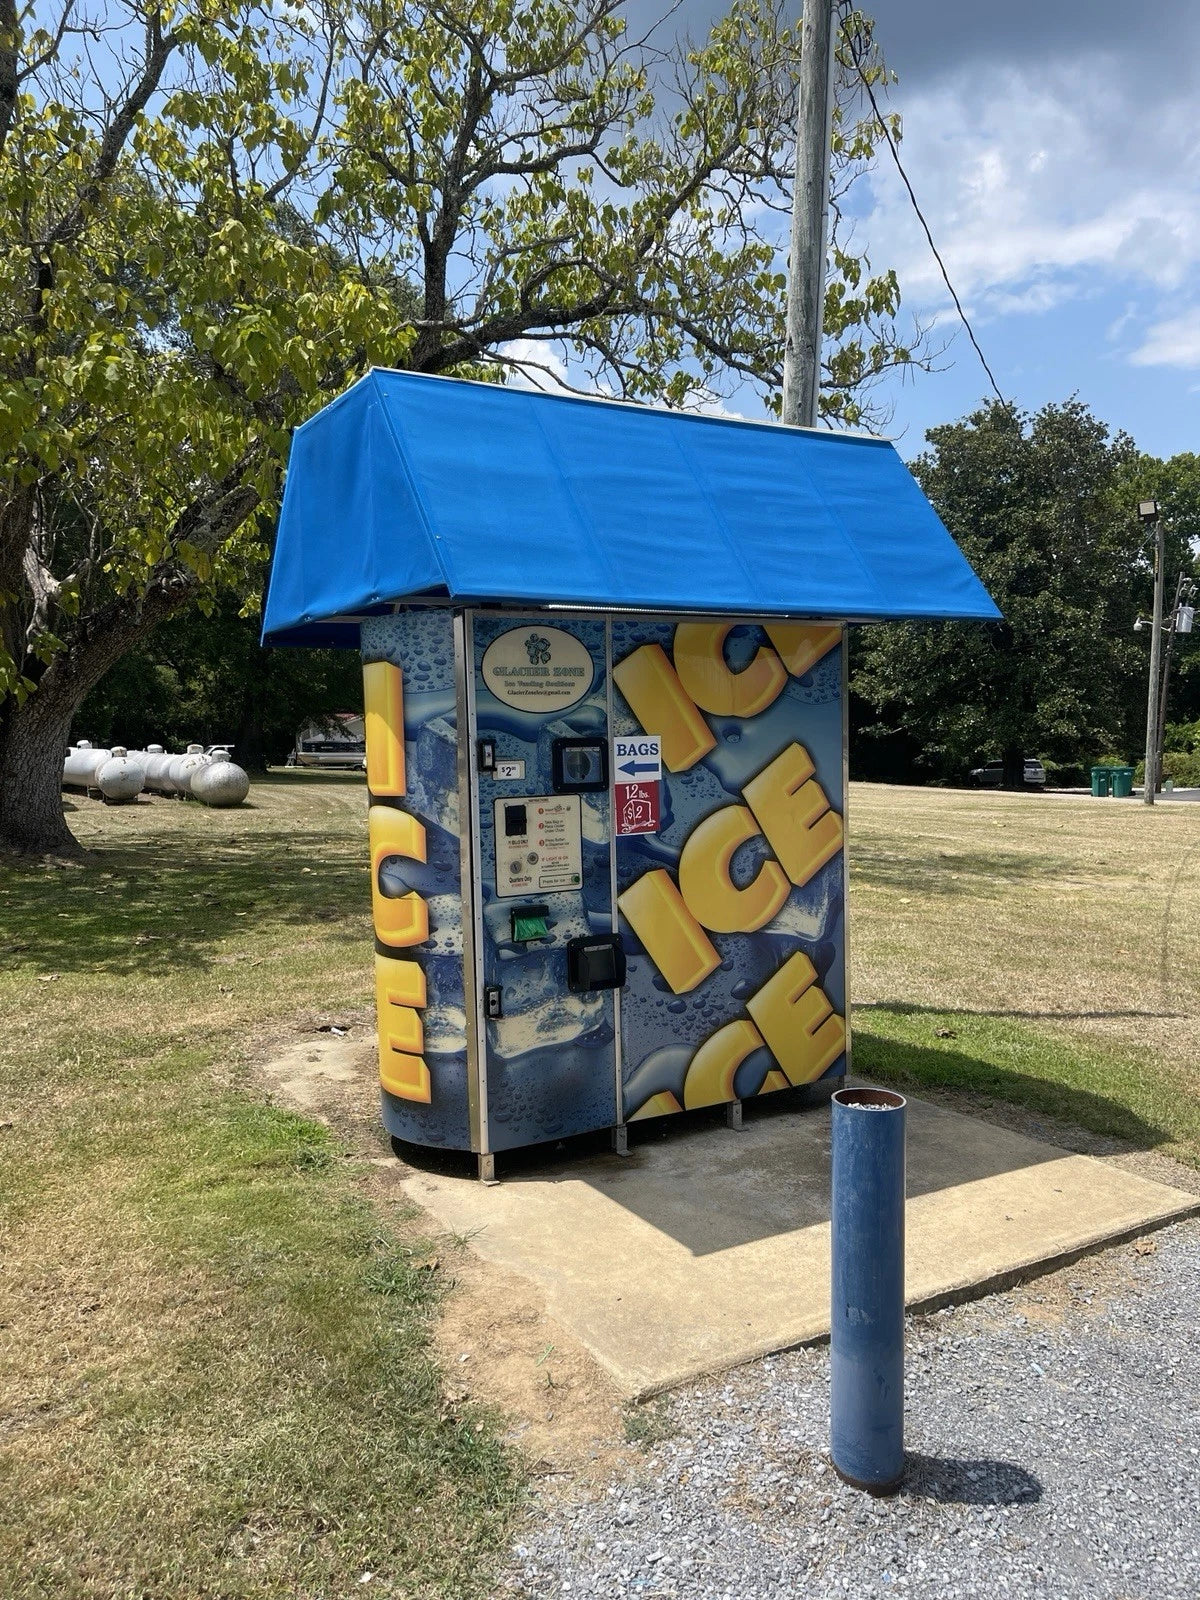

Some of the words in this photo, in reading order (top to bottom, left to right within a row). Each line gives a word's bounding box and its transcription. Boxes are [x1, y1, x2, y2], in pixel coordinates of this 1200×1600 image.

[492, 666, 551, 677] GLACIER
[552, 666, 585, 677] ZONE
[616, 743, 659, 757] BAGS
[625, 784, 638, 800] 12
[627, 806, 643, 820] $2
[617, 742, 845, 994] ICE
[362, 661, 432, 1104] ICE
